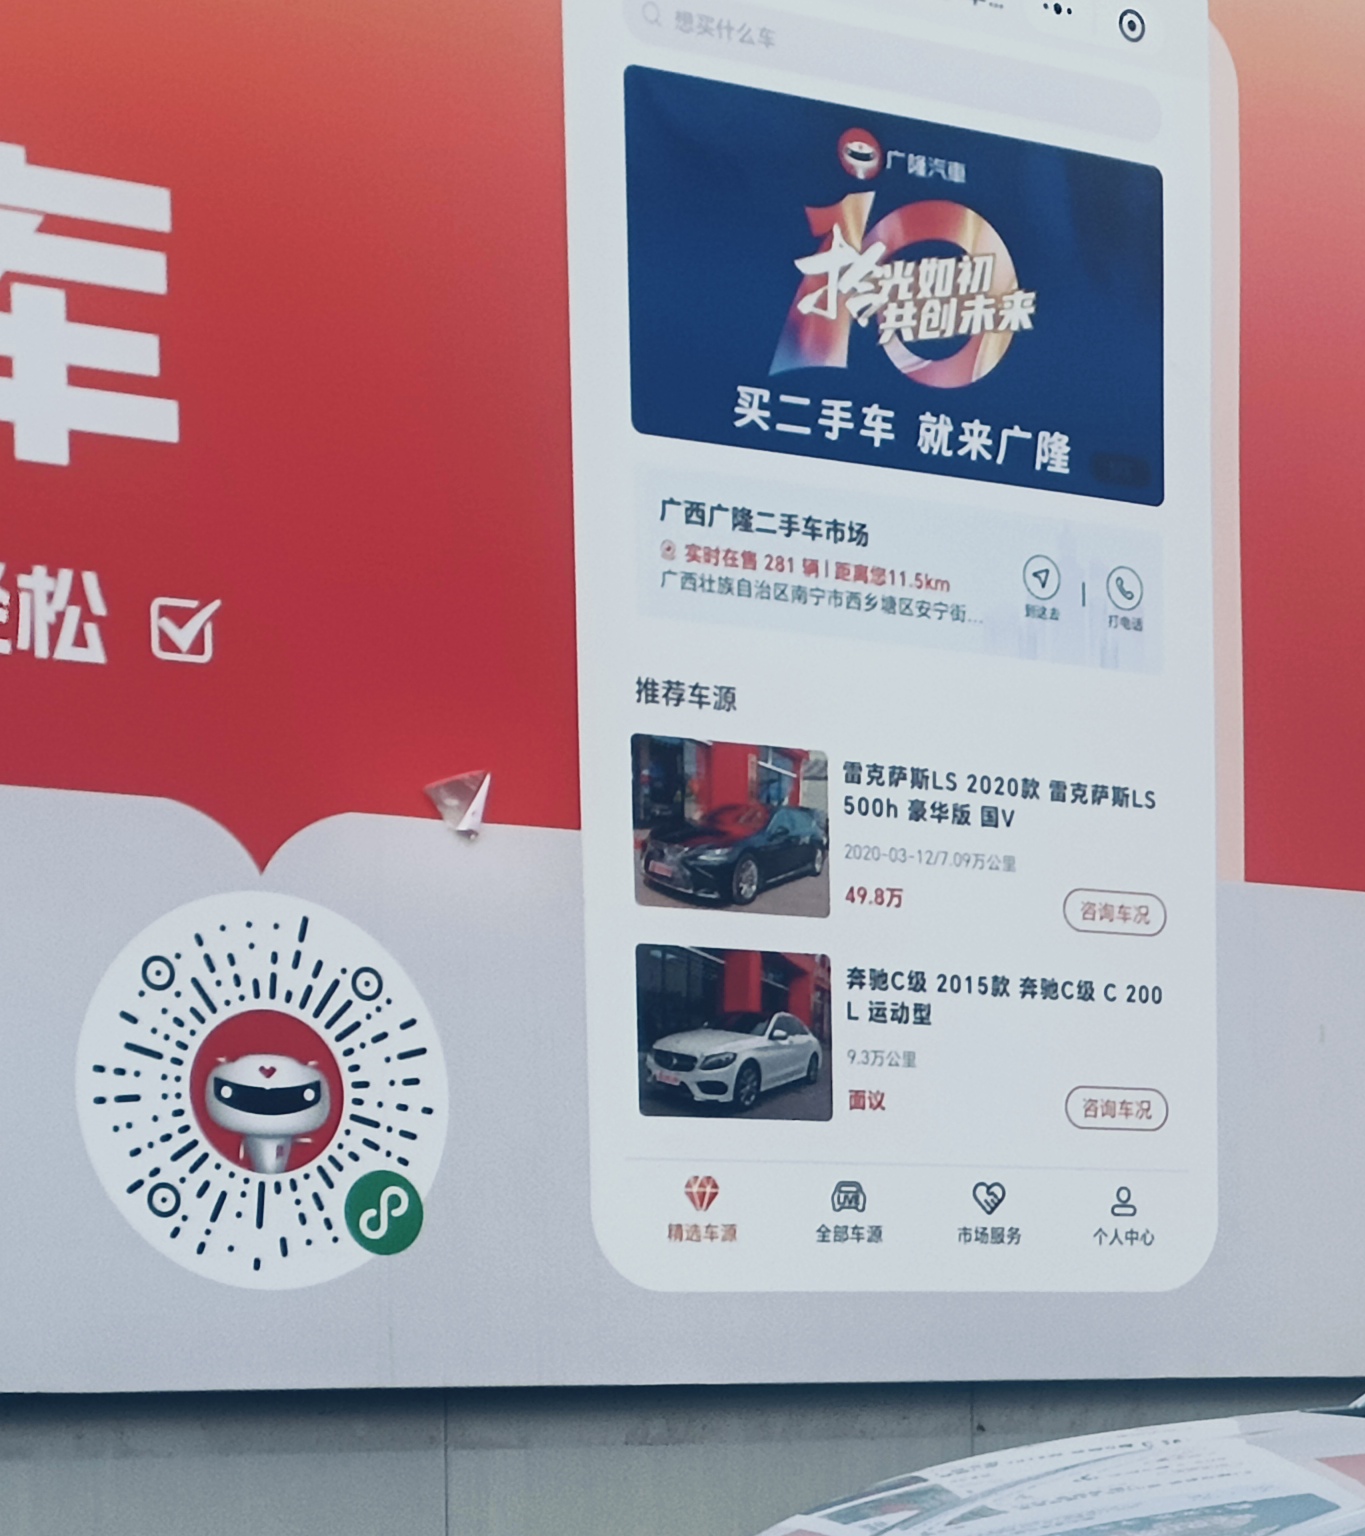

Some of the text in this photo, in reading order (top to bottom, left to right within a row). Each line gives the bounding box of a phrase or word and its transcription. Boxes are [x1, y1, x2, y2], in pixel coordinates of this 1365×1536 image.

[674, 11, 776, 48] 想买什么车
[885, 149, 966, 183] 广隆汽車
[878, 290, 1036, 344] 共创未来
[733, 385, 1071, 474] 买二手车 就来广隆
[659, 498, 869, 547] 广西广隆二手车市场
[685, 543, 758, 571] 实时在售
[765, 552, 795, 572] 281
[1107, 614, 1144, 633] 打电话
[635, 676, 738, 712] 推荐车源
[843, 760, 1157, 811] 雷克萨斯LS 2020款 雷克萨斯LS
[843, 795, 1016, 829] 500h 豪华版 国V
[845, 885, 1152, 927] 49.8万 咨询车况
[846, 966, 1164, 1005] 奔驰C级 2015款 奔驰C级 C 200
[847, 1002, 933, 1026] L 运动型
[847, 1049, 918, 1069] 9.3万公里
[848, 1089, 887, 1112] 面议
[1082, 1097, 1153, 1122] 咨询车况
[667, 1223, 738, 1244] 精选车源
[815, 1224, 883, 1245] 全部车源
[957, 1226, 1022, 1246] 市场服务
[1093, 1228, 1155, 1247] 个人中心
